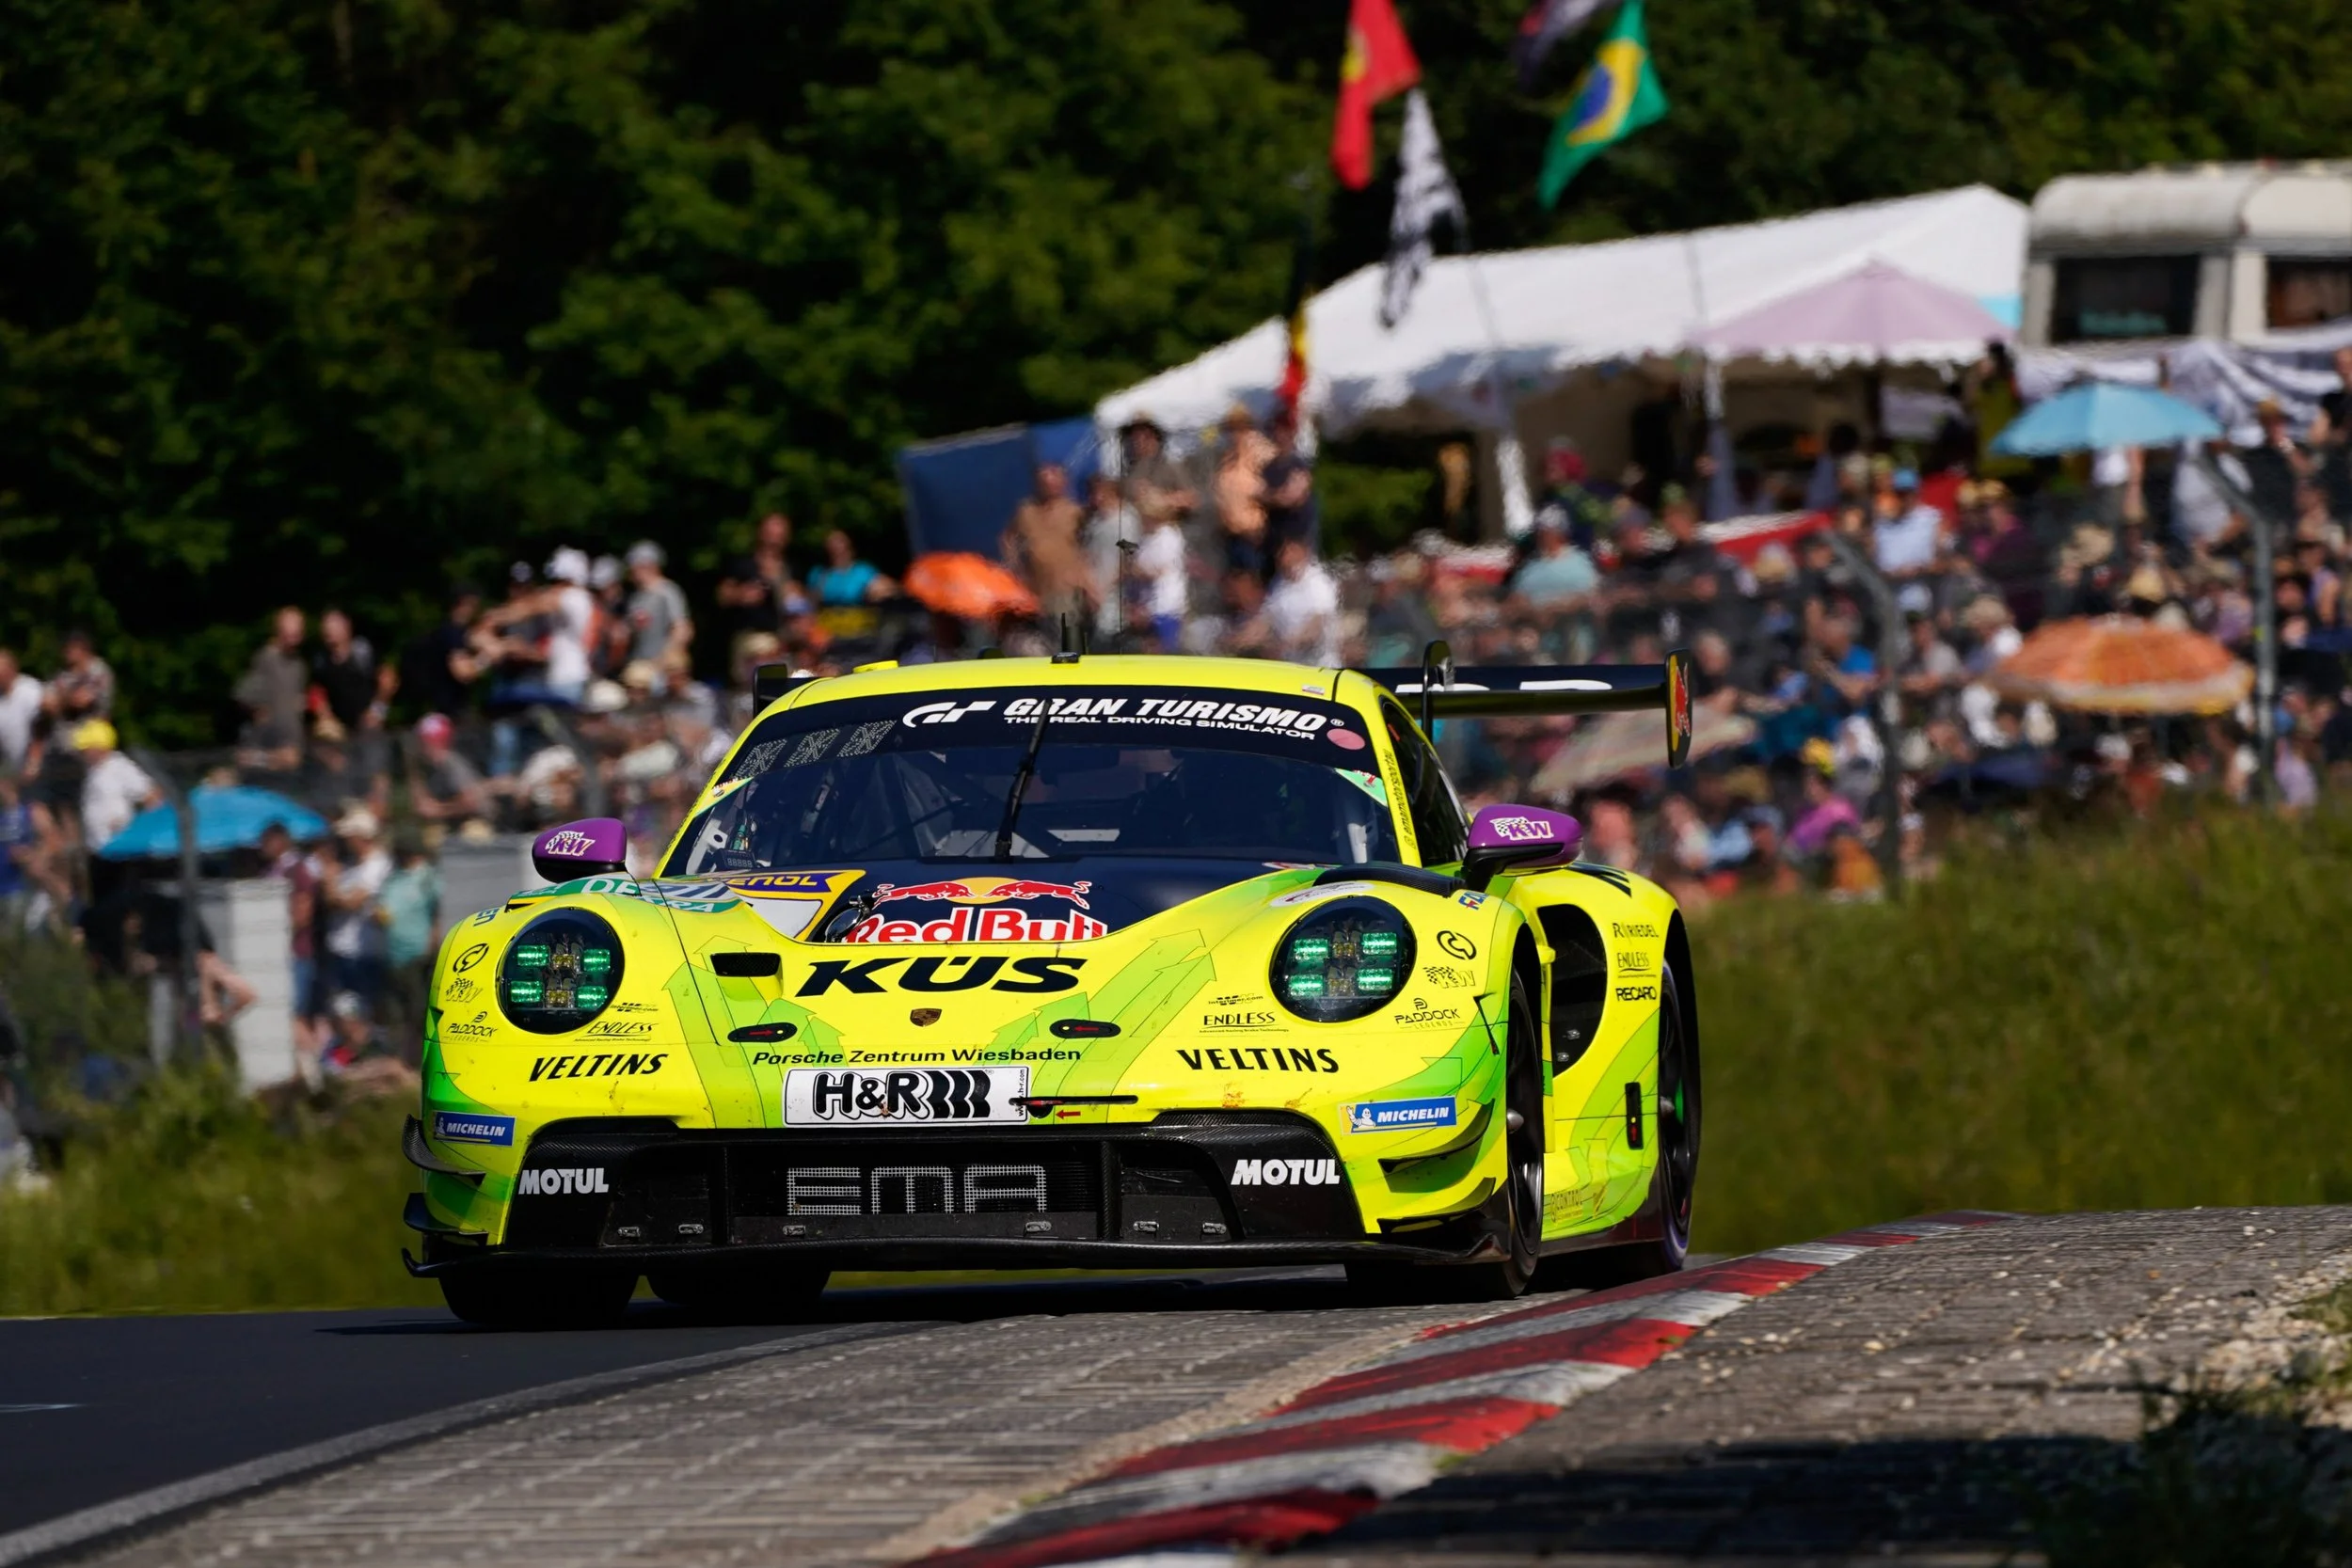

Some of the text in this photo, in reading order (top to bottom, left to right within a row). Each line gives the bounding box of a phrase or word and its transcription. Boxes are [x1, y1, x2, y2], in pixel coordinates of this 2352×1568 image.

[1003, 698, 1327, 732] GRAN TURISMO
[1107, 716, 1192, 726] DRIVING
[1195, 720, 1316, 740] SIMULATOR
[1507, 820, 1554, 841] KW
[1616, 952, 1650, 968] ENDLESS
[794, 956, 1089, 997] KÜS
[1615, 986, 1657, 1001] RECARO
[1203, 1012, 1275, 1025] ENDLESS
[1394, 1008, 1460, 1023] PADDOCK
[446, 1022, 499, 1037] PADDOCK
[587, 1021, 660, 1034] ENDLESS
[753, 1048, 1081, 1065] Porsche Zentrum Wiesbaden
[1175, 1048, 1340, 1073] VELTINS
[529, 1053, 669, 1082] VELTINS
[812, 1069, 930, 1120] H&R
[1376, 1106, 1450, 1123] MICHELIN
[446, 1122, 506, 1137] MICHELIN
[517, 1167, 610, 1196] MOTUL
[1231, 1159, 1340, 1185] MOTUL
[787, 1164, 1047, 1215] EMA
